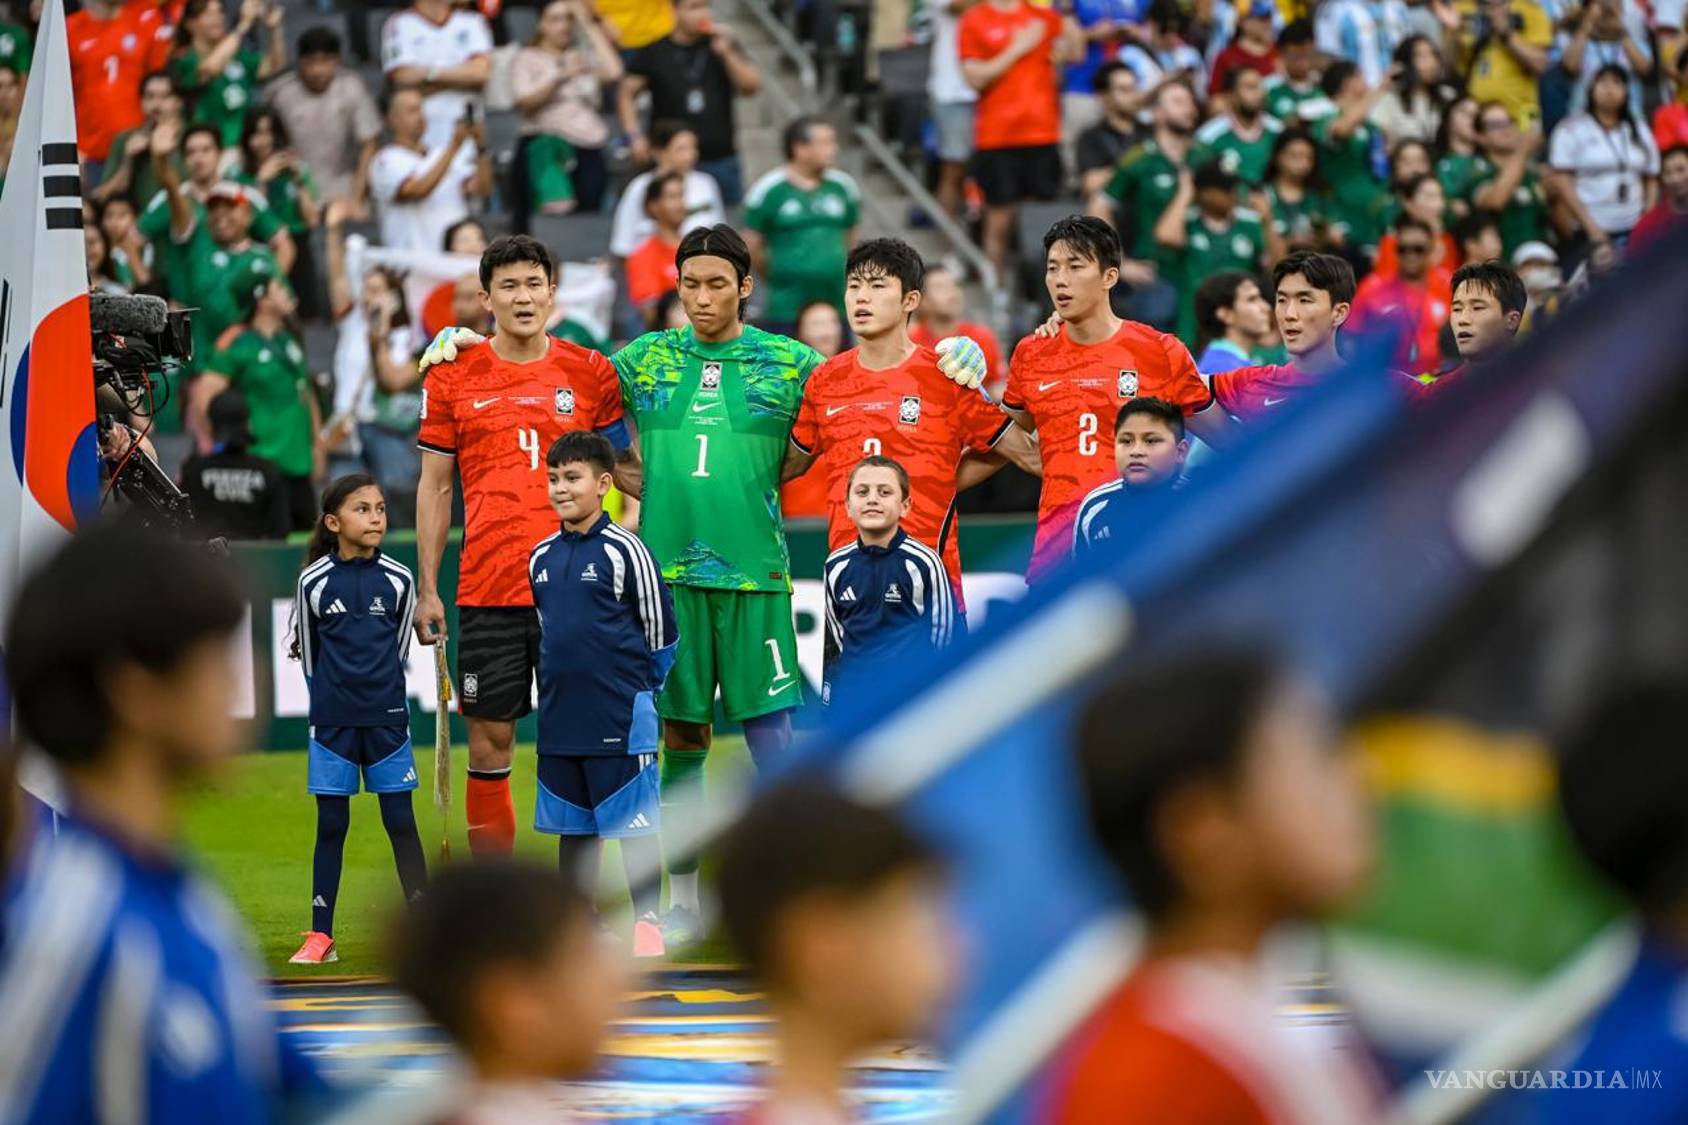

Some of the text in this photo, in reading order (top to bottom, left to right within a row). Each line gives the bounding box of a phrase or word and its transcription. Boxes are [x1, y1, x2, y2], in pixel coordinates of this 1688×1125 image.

[518, 428, 540, 471] 4
[691, 434, 710, 477] 1
[1079, 413, 1098, 456] 2
[764, 638, 791, 682] 1
